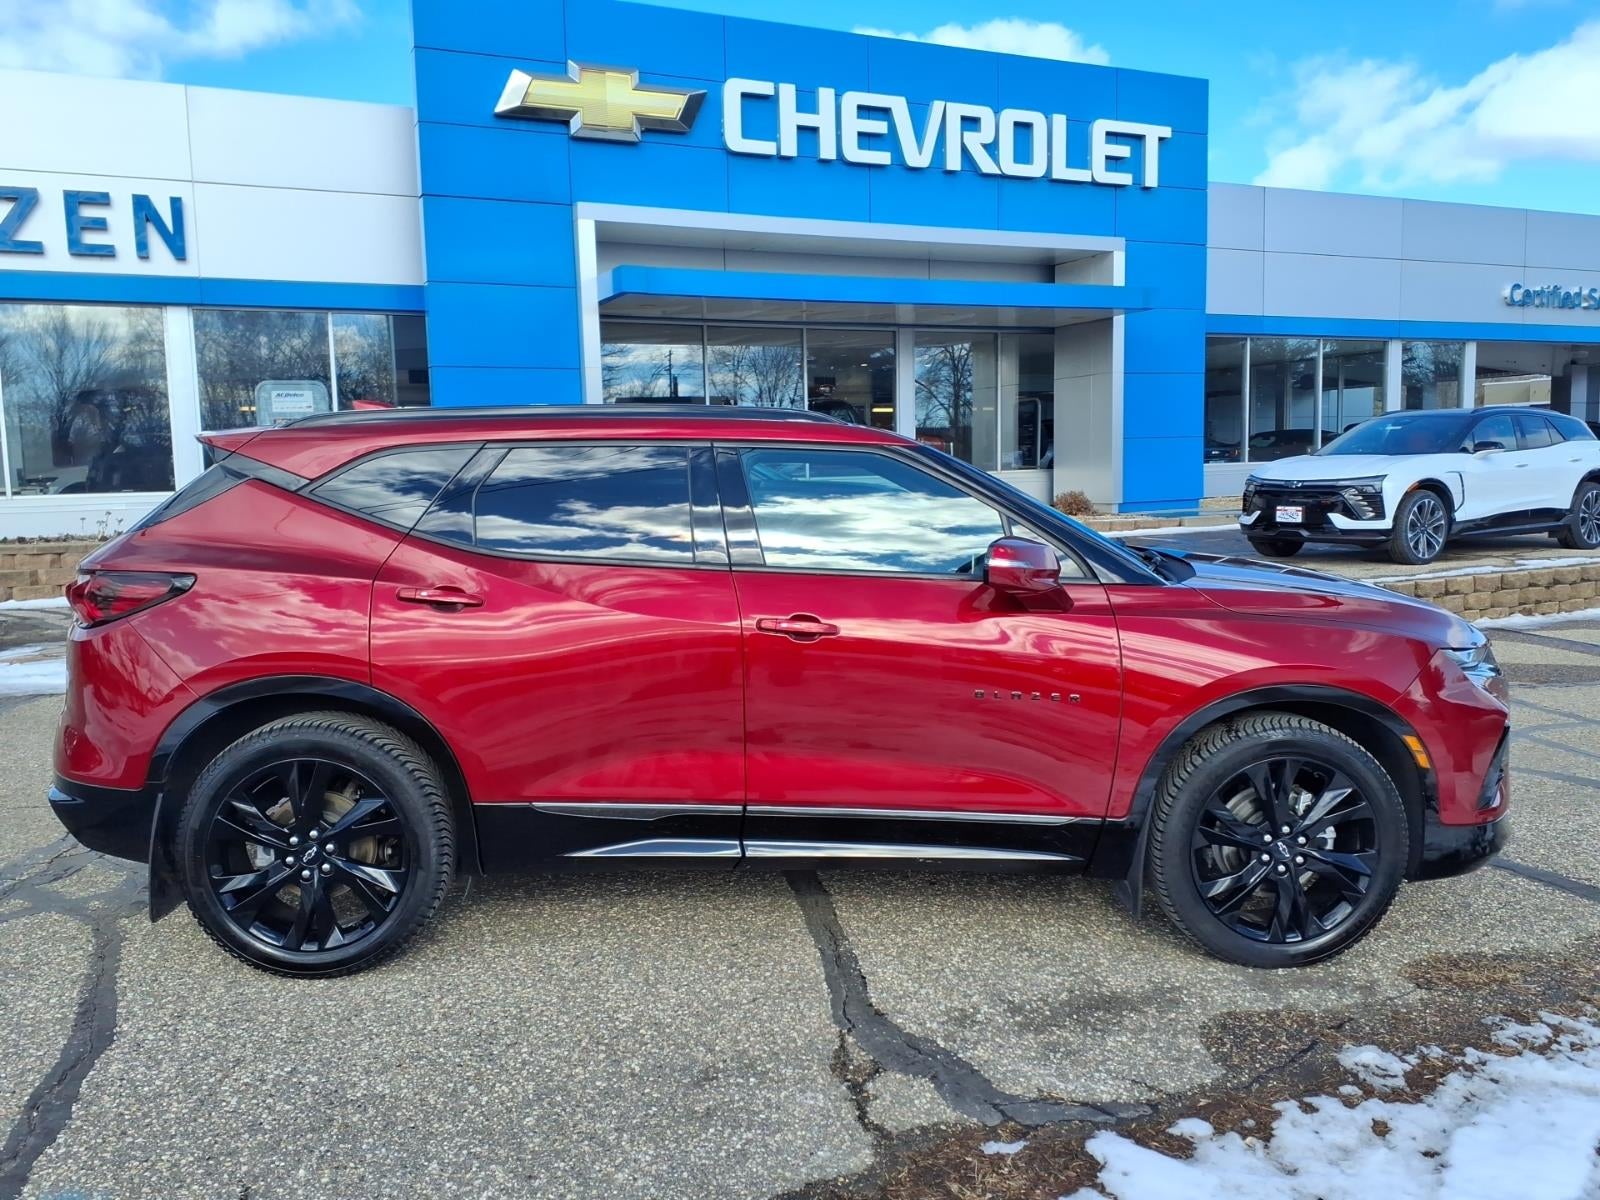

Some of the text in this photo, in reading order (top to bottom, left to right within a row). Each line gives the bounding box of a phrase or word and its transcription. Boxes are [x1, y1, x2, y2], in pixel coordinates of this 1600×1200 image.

[722, 77, 1172, 188] CHEVROLET
[0, 186, 187, 260] ZEN
[1504, 283, 1583, 309] Certified
[974, 689, 1080, 702] BLAZER
